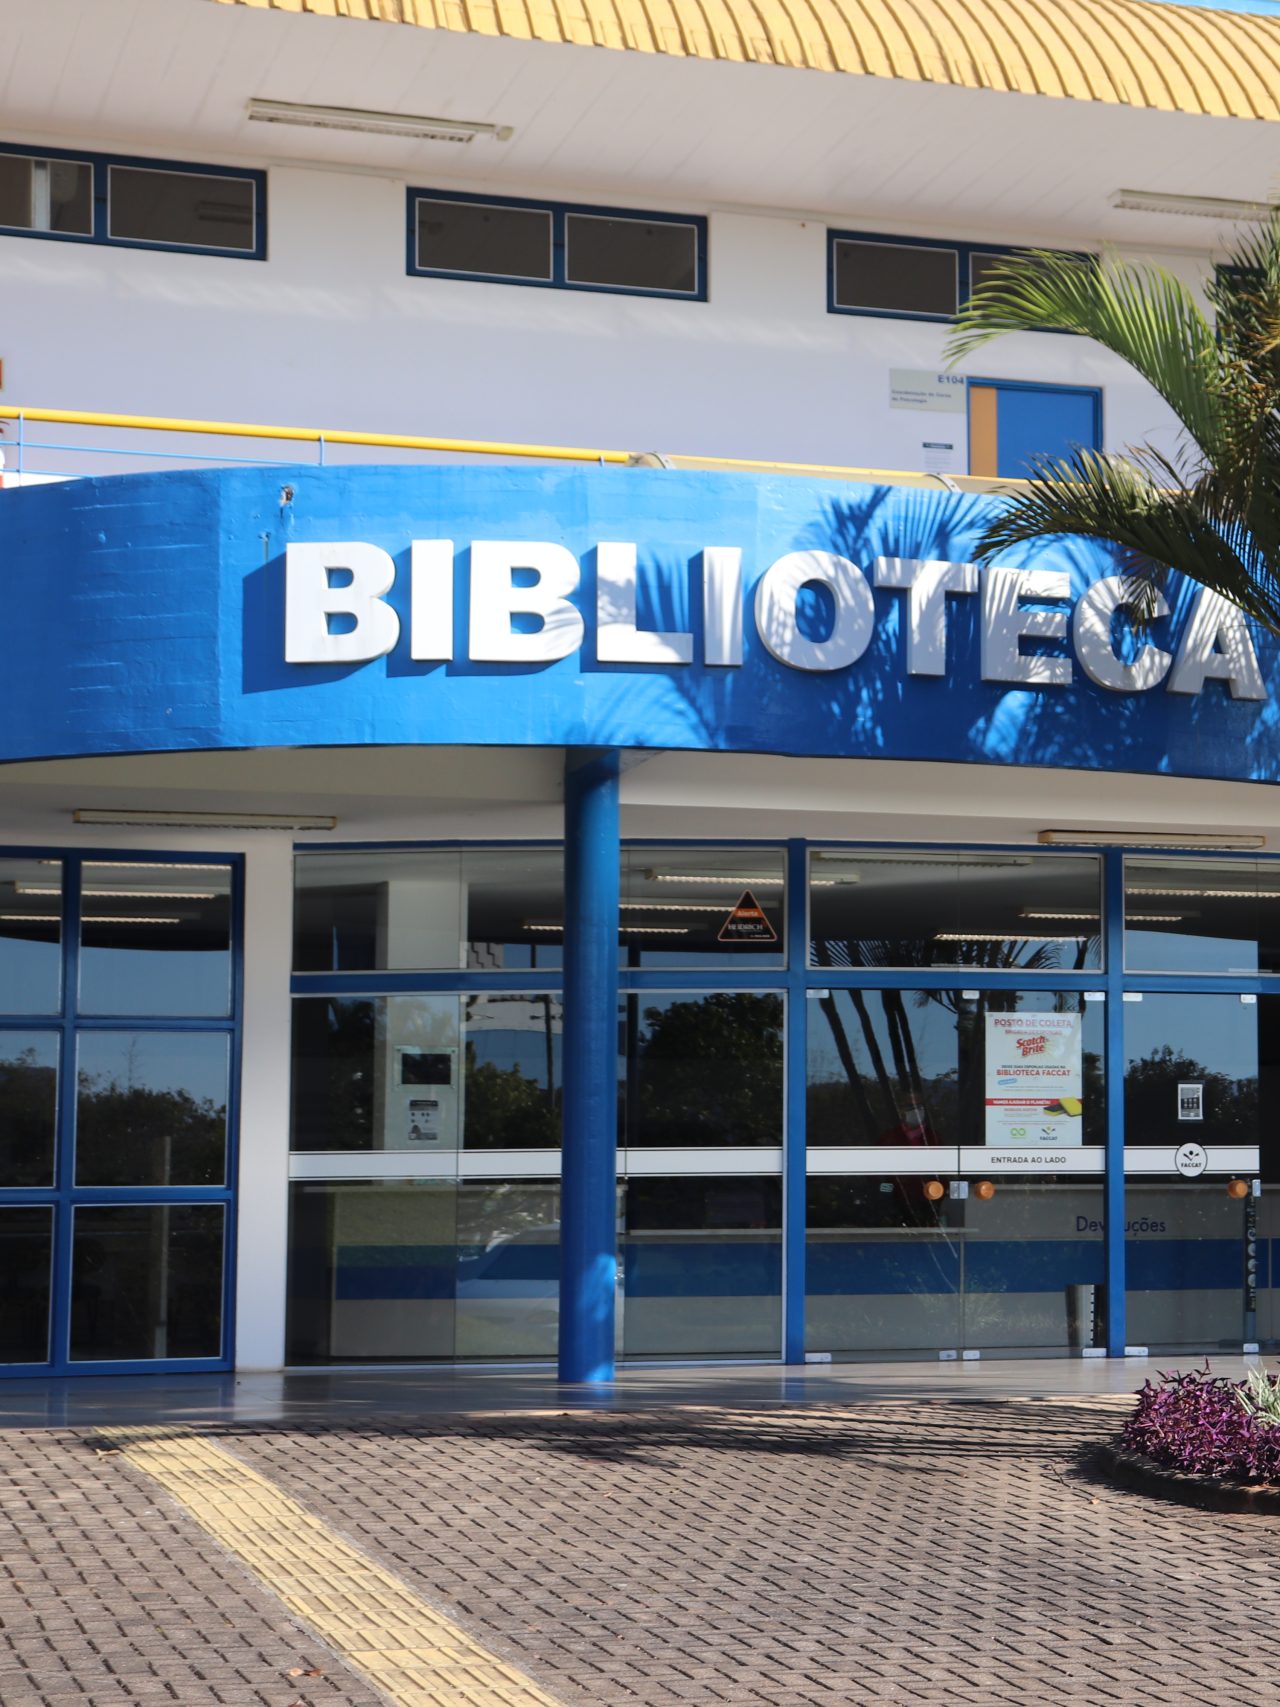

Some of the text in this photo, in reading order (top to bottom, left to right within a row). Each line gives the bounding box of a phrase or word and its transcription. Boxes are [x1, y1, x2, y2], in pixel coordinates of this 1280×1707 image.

[938, 374, 965, 385] E104
[285, 538, 1266, 701] BIBLIOTECA
[994, 1019, 1023, 1027] POSTO
[1025, 1019, 1037, 1027] DE
[1022, 1044, 1045, 1057] Brite
[1042, 1069, 1071, 1077] FACCAT
[991, 1156, 1066, 1164] ENTRADA AO LADO
[1076, 1216, 1166, 1236] Devuções
